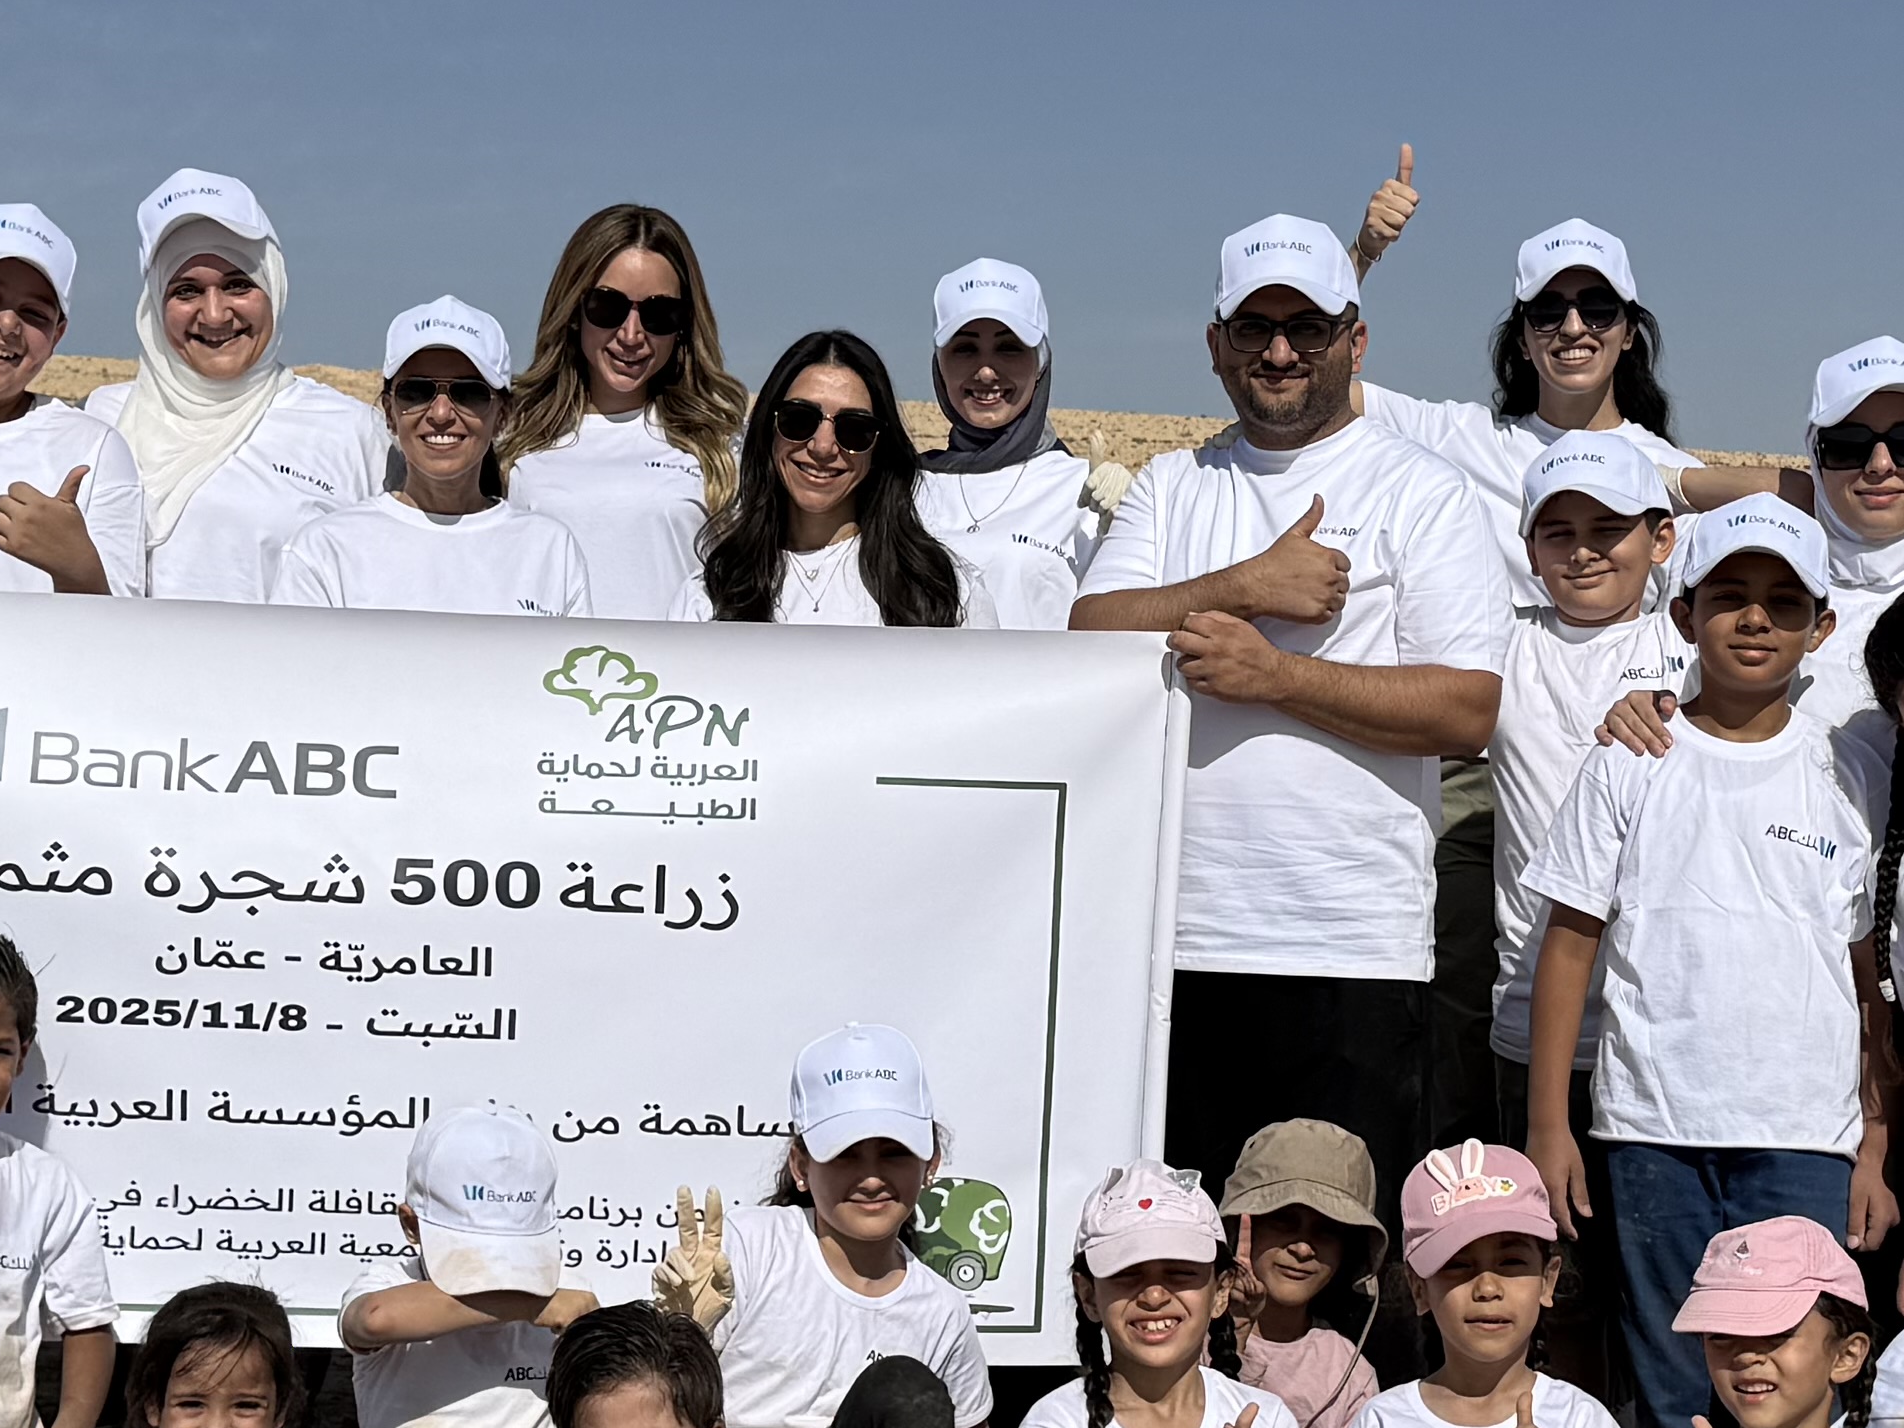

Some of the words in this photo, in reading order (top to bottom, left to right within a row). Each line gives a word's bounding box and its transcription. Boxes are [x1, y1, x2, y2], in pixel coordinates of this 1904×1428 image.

[604, 695, 750, 750] APN
[537, 751, 641, 783] لحماية
[650, 755, 758, 786] العربية
[1765, 824, 1798, 843] ABC
[143, 844, 365, 917] شجرة
[389, 858, 543, 909] 500
[557, 859, 742, 931] زراعة
[55, 996, 308, 1034] 2025/11/8
[31, 1083, 188, 1128] العربية
[207, 1091, 430, 1137] المؤسسة
[639, 1103, 796, 1138] ساهمة
[552, 1110, 620, 1143] من
[93, 1180, 142, 1221] في
[155, 1184, 294, 1216] الخضراء
[308, 1188, 399, 1215] قافلة
[556, 1195, 643, 1228] برنام
[216, 1229, 326, 1260] العربية
[339, 1233, 419, 1263] معية
[504, 1366, 534, 1382] ABC
